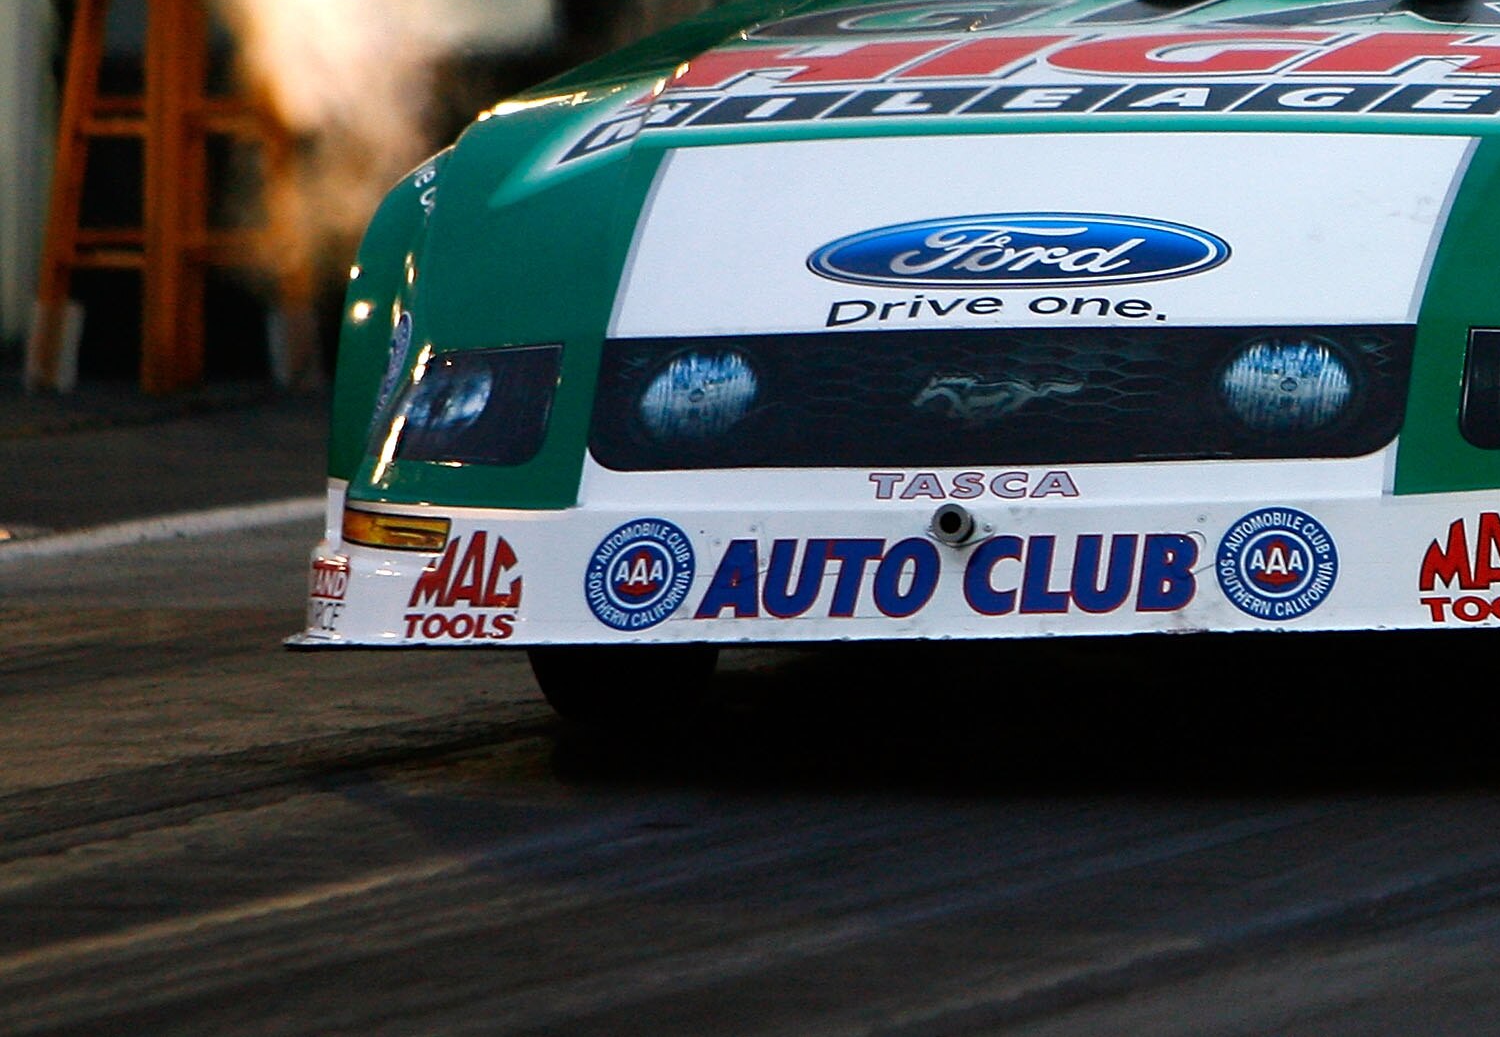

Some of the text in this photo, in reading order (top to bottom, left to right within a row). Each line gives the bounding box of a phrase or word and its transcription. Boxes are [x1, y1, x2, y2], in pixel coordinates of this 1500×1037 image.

[889, 224, 1146, 274] Ford
[826, 294, 1168, 327] Drive one.
[869, 471, 1080, 500] TASCA
[596, 523, 691, 564] AUTOMOBILE CLUB
[1225, 512, 1330, 554] AUTOMOBILE CLUB
[407, 530, 523, 608] MAC
[614, 558, 664, 586] AAA
[694, 534, 1199, 619] AUTO CLUB
[1250, 547, 1304, 575] AAA
[312, 569, 347, 597] AND
[588, 570, 692, 627] SOUTHERN CALIFORNIA
[1220, 559, 1334, 616] SOUTHERN CALIFORNIA
[403, 613, 519, 639] TOOLS
